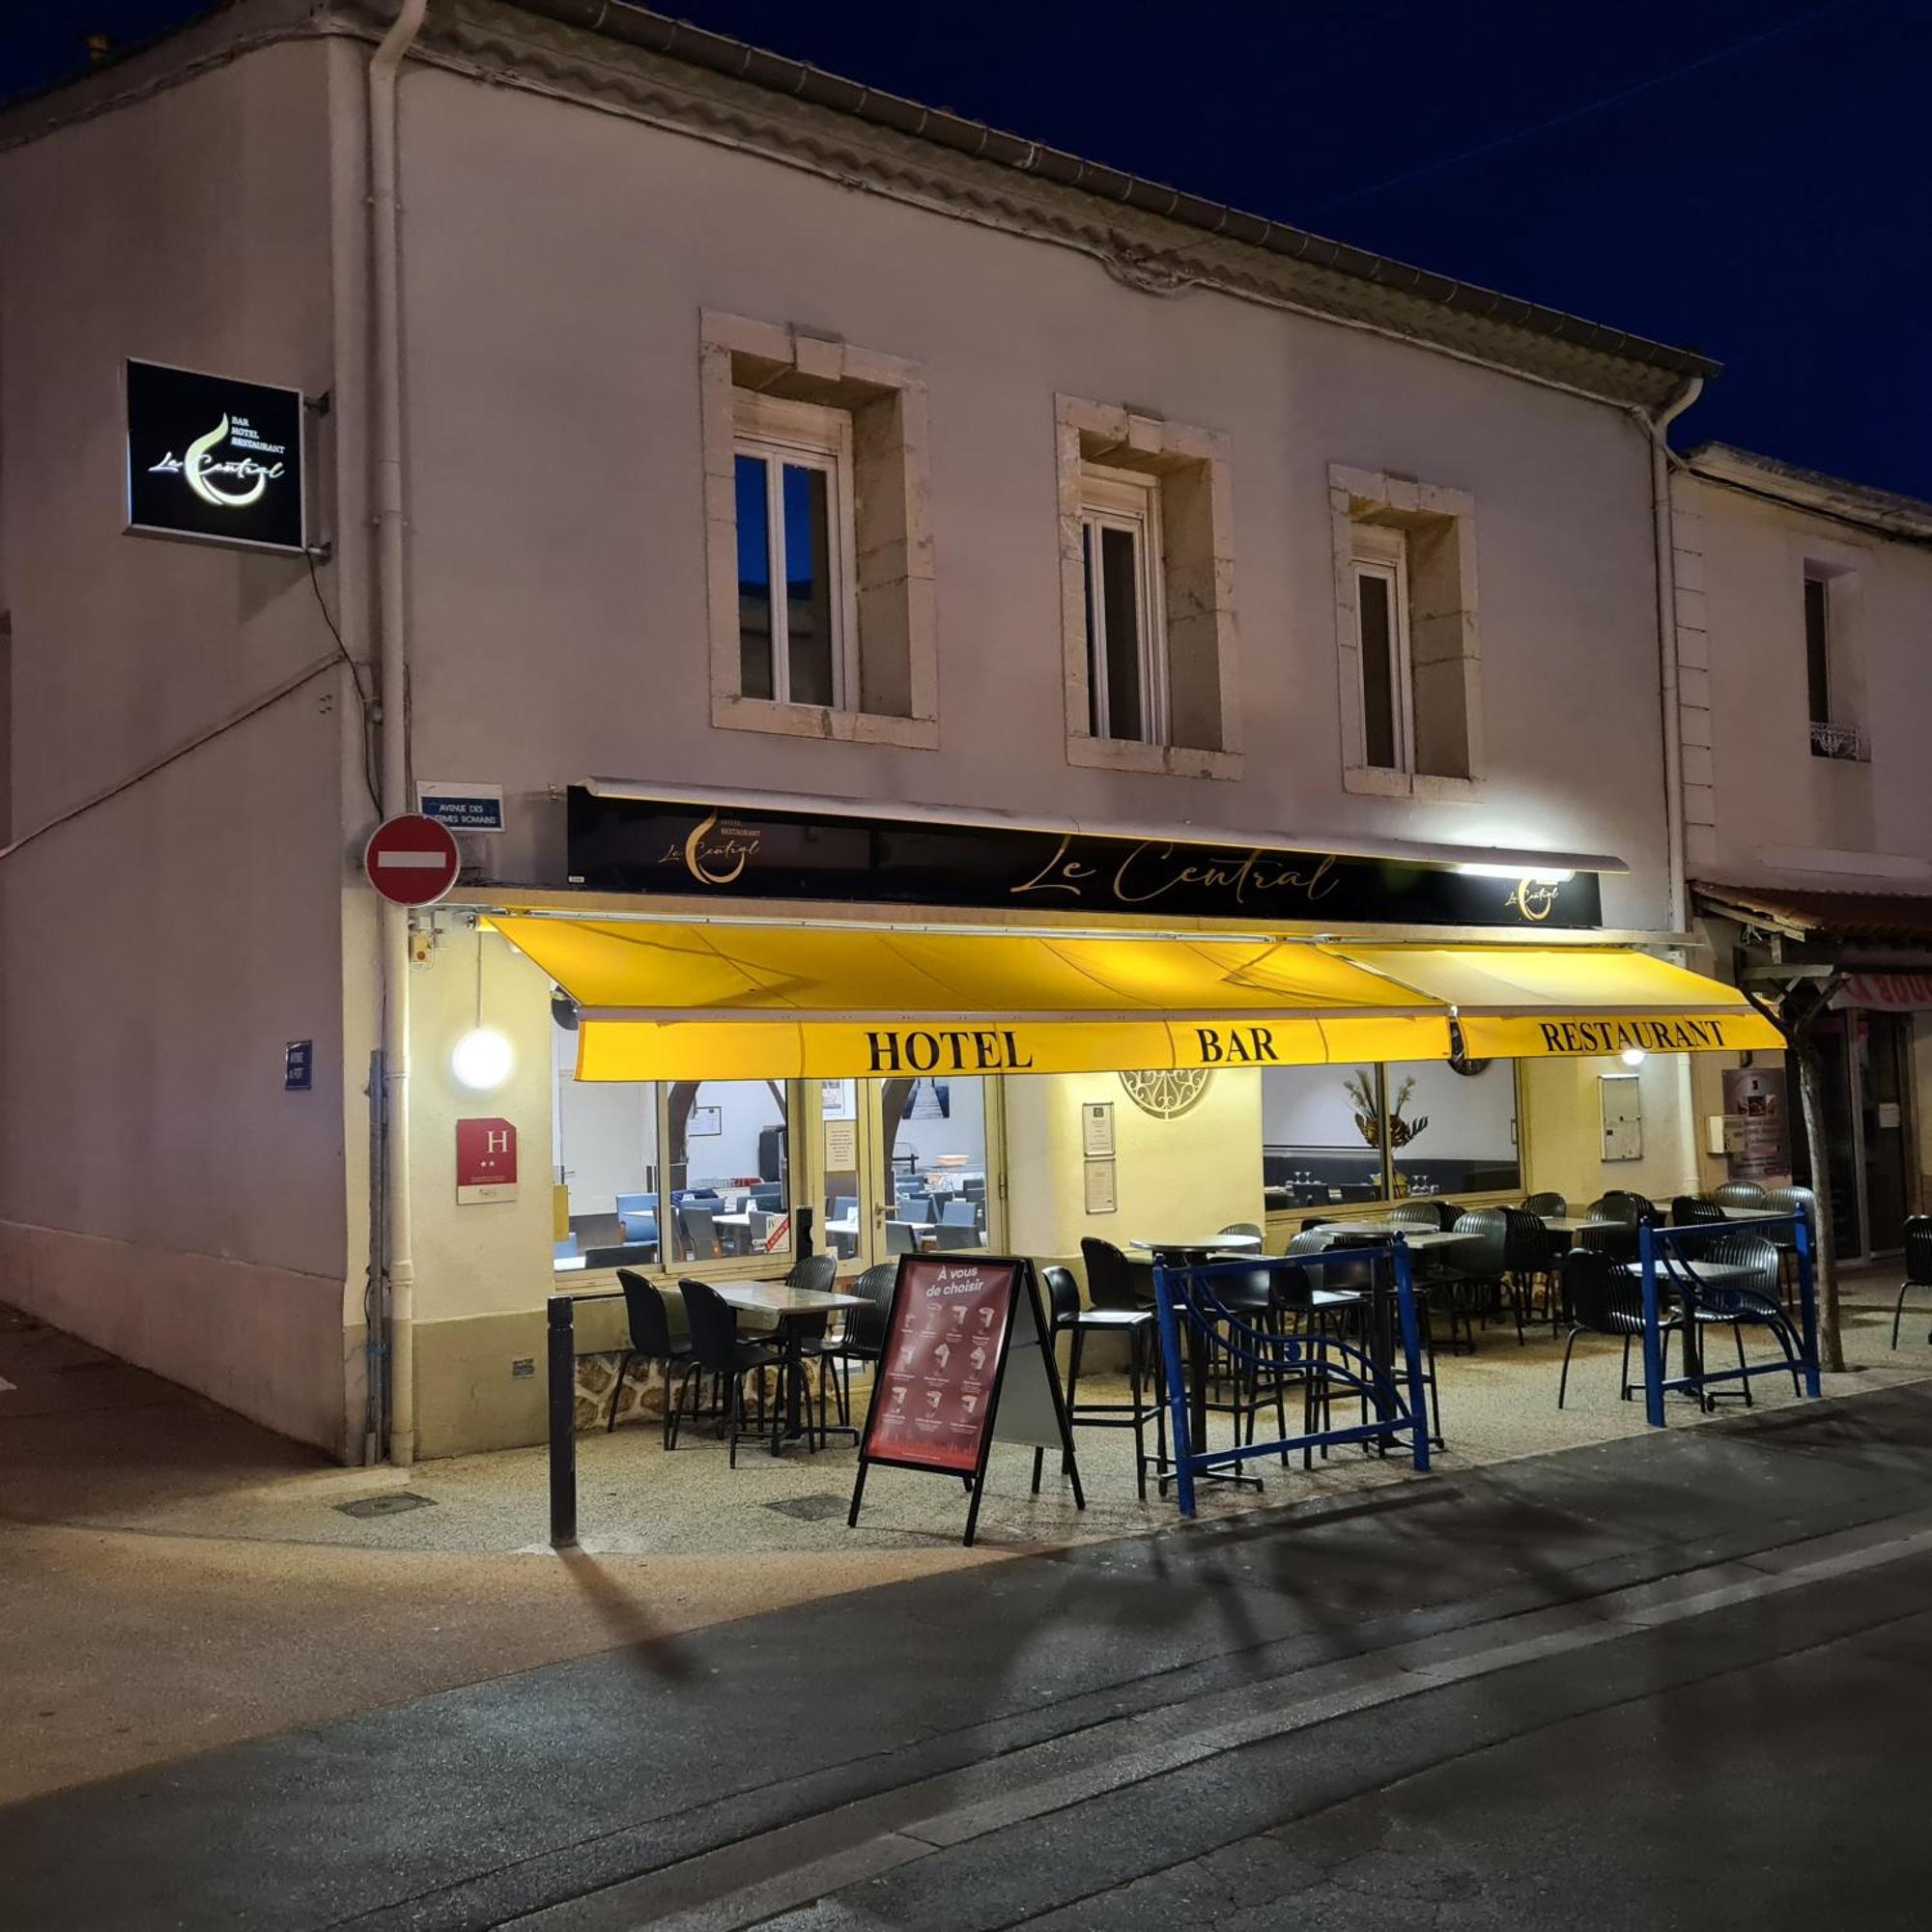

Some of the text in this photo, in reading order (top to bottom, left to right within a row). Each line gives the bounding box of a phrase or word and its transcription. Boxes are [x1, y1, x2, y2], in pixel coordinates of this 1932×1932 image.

[232, 415, 249, 426] BAR
[232, 427, 260, 440] HOTEL
[231, 437, 286, 454] RESTAURANT
[148, 451, 184, 472] Le
[440, 804, 467, 812] AVENUE
[658, 844, 682, 863] Le
[1010, 834, 1339, 904] Le Central
[1195, 1027, 1279, 1064] BAR
[1538, 1020, 1725, 1052] RESTAURANT
[865, 1030, 1033, 1071] HOTEL
[487, 1129, 509, 1153] H
[951, 1267, 978, 1279] vous
[926, 1279, 984, 1297] de choisir
